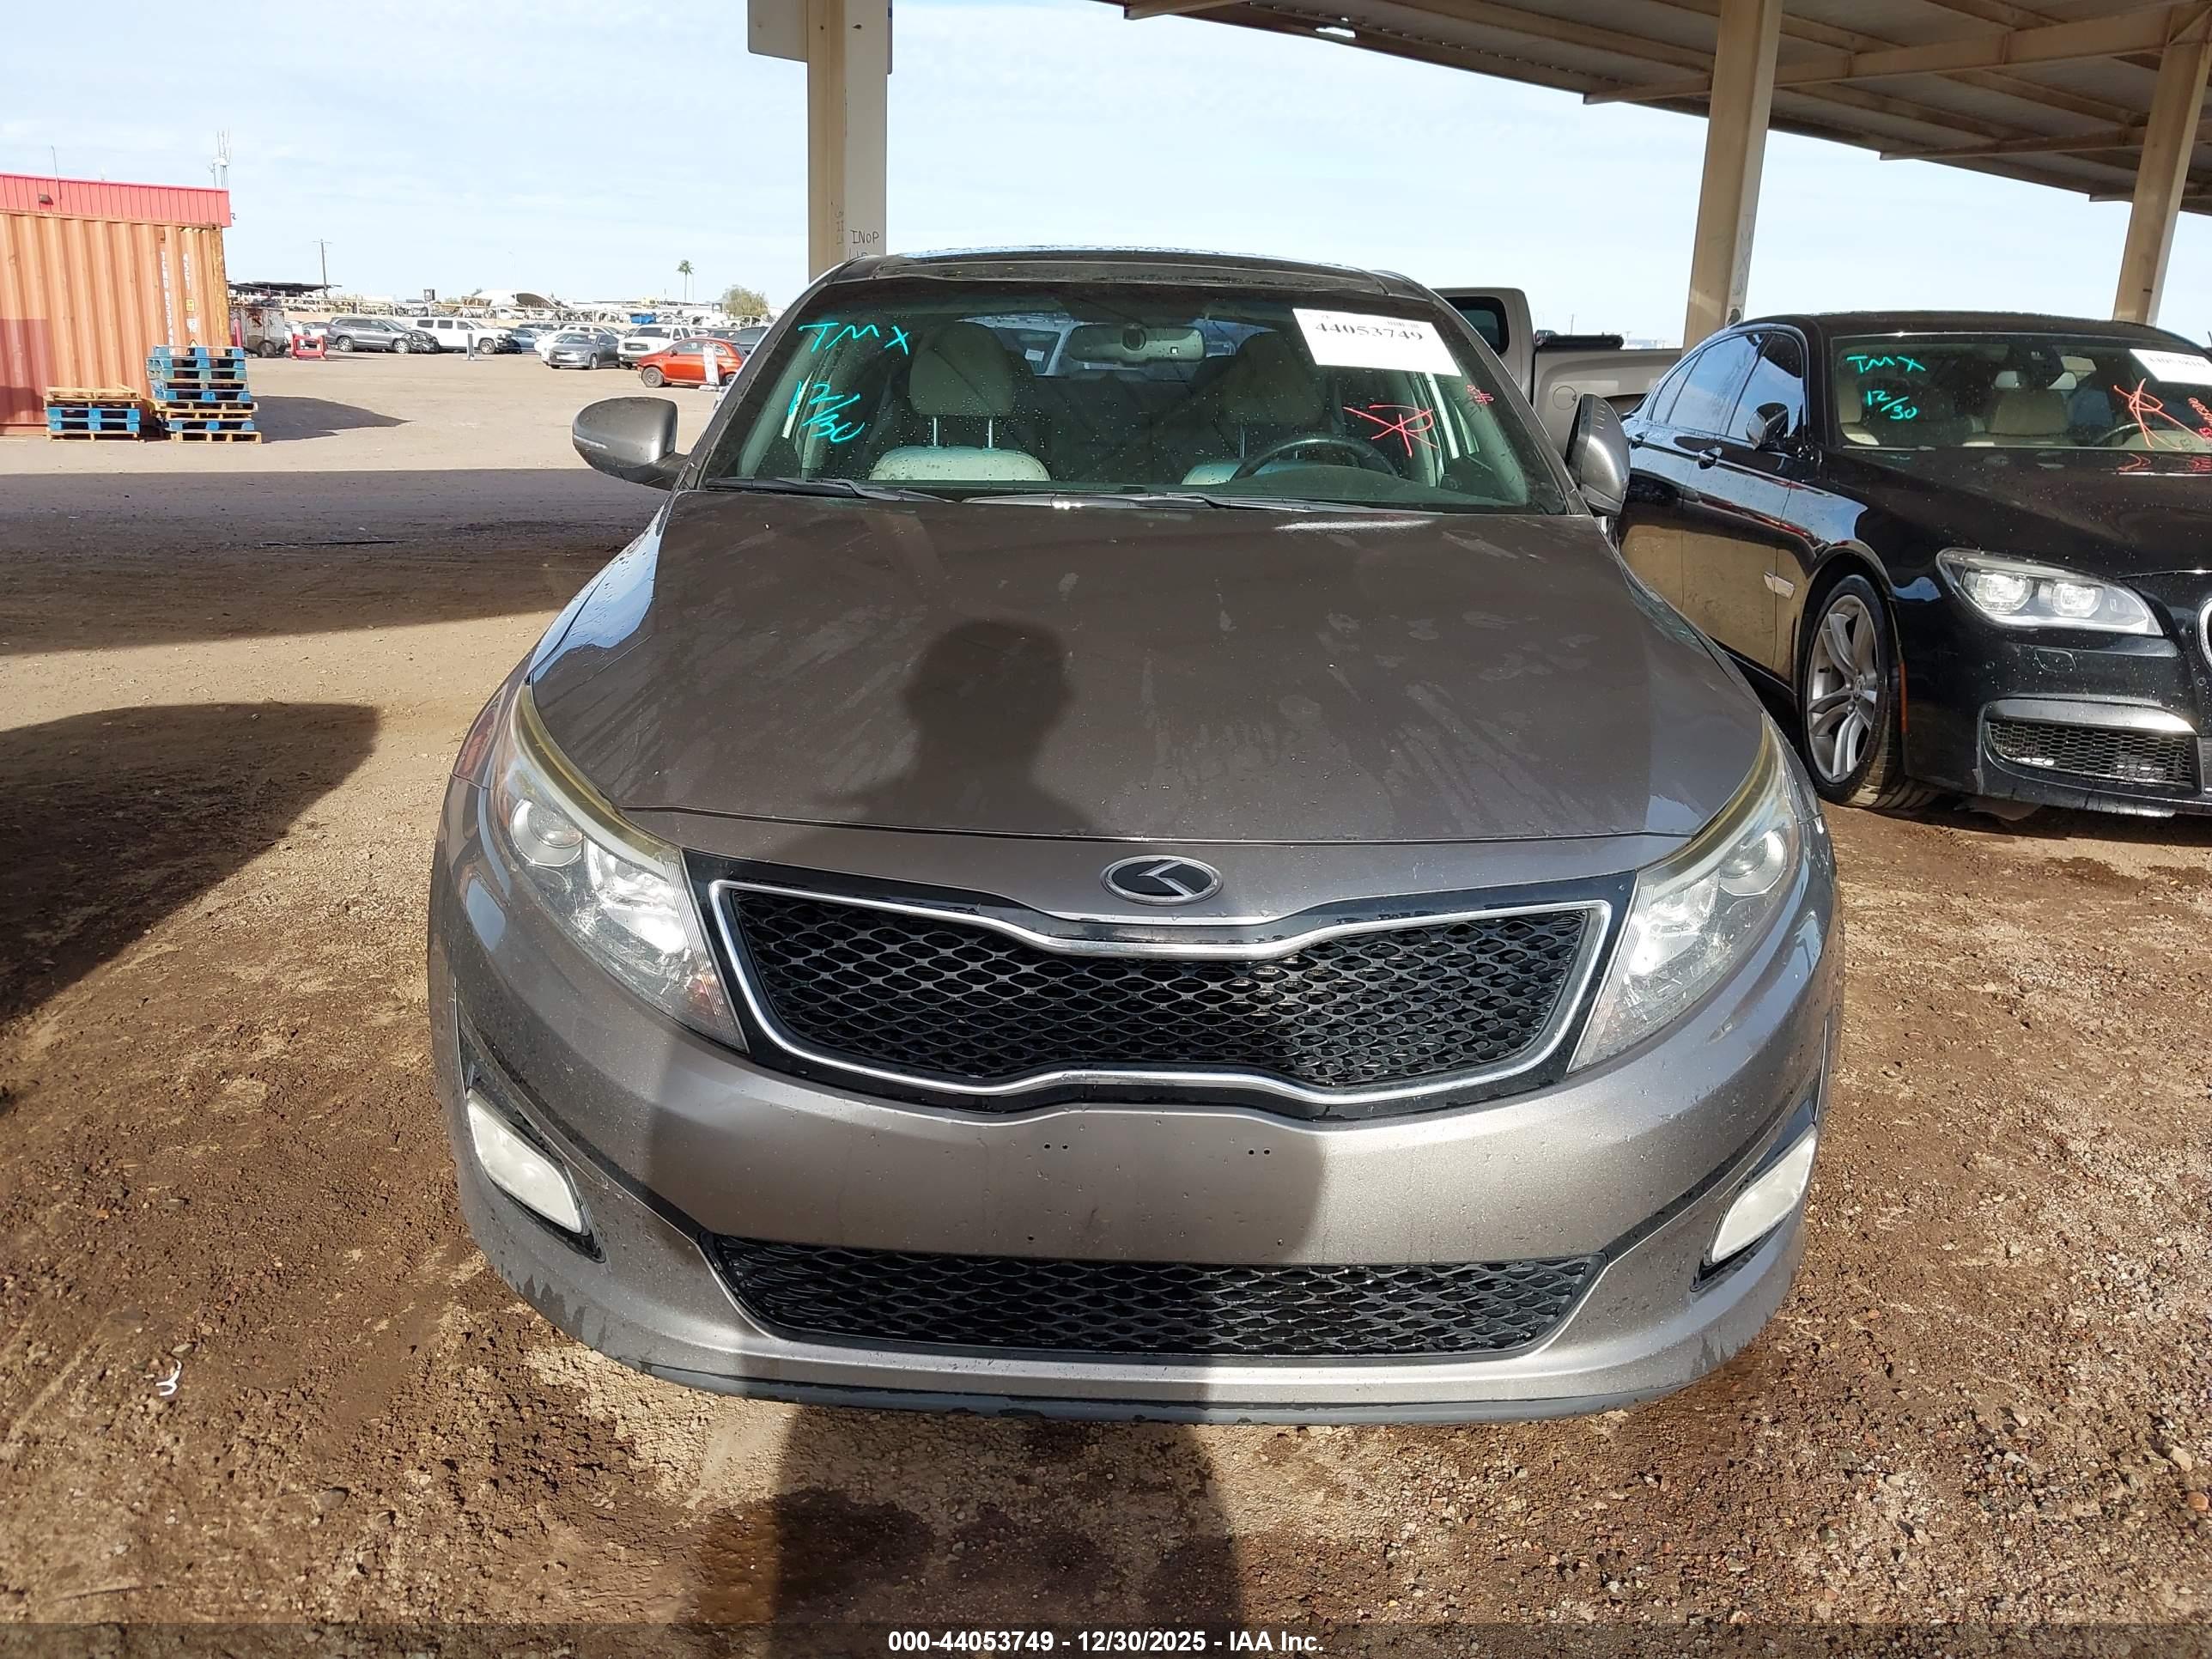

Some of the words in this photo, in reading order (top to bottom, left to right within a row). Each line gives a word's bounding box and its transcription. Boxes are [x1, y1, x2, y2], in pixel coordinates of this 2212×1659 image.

[798, 322, 910, 356] TMX
[1315, 321, 1424, 342] 44053749
[1846, 355, 1927, 374] TMX
